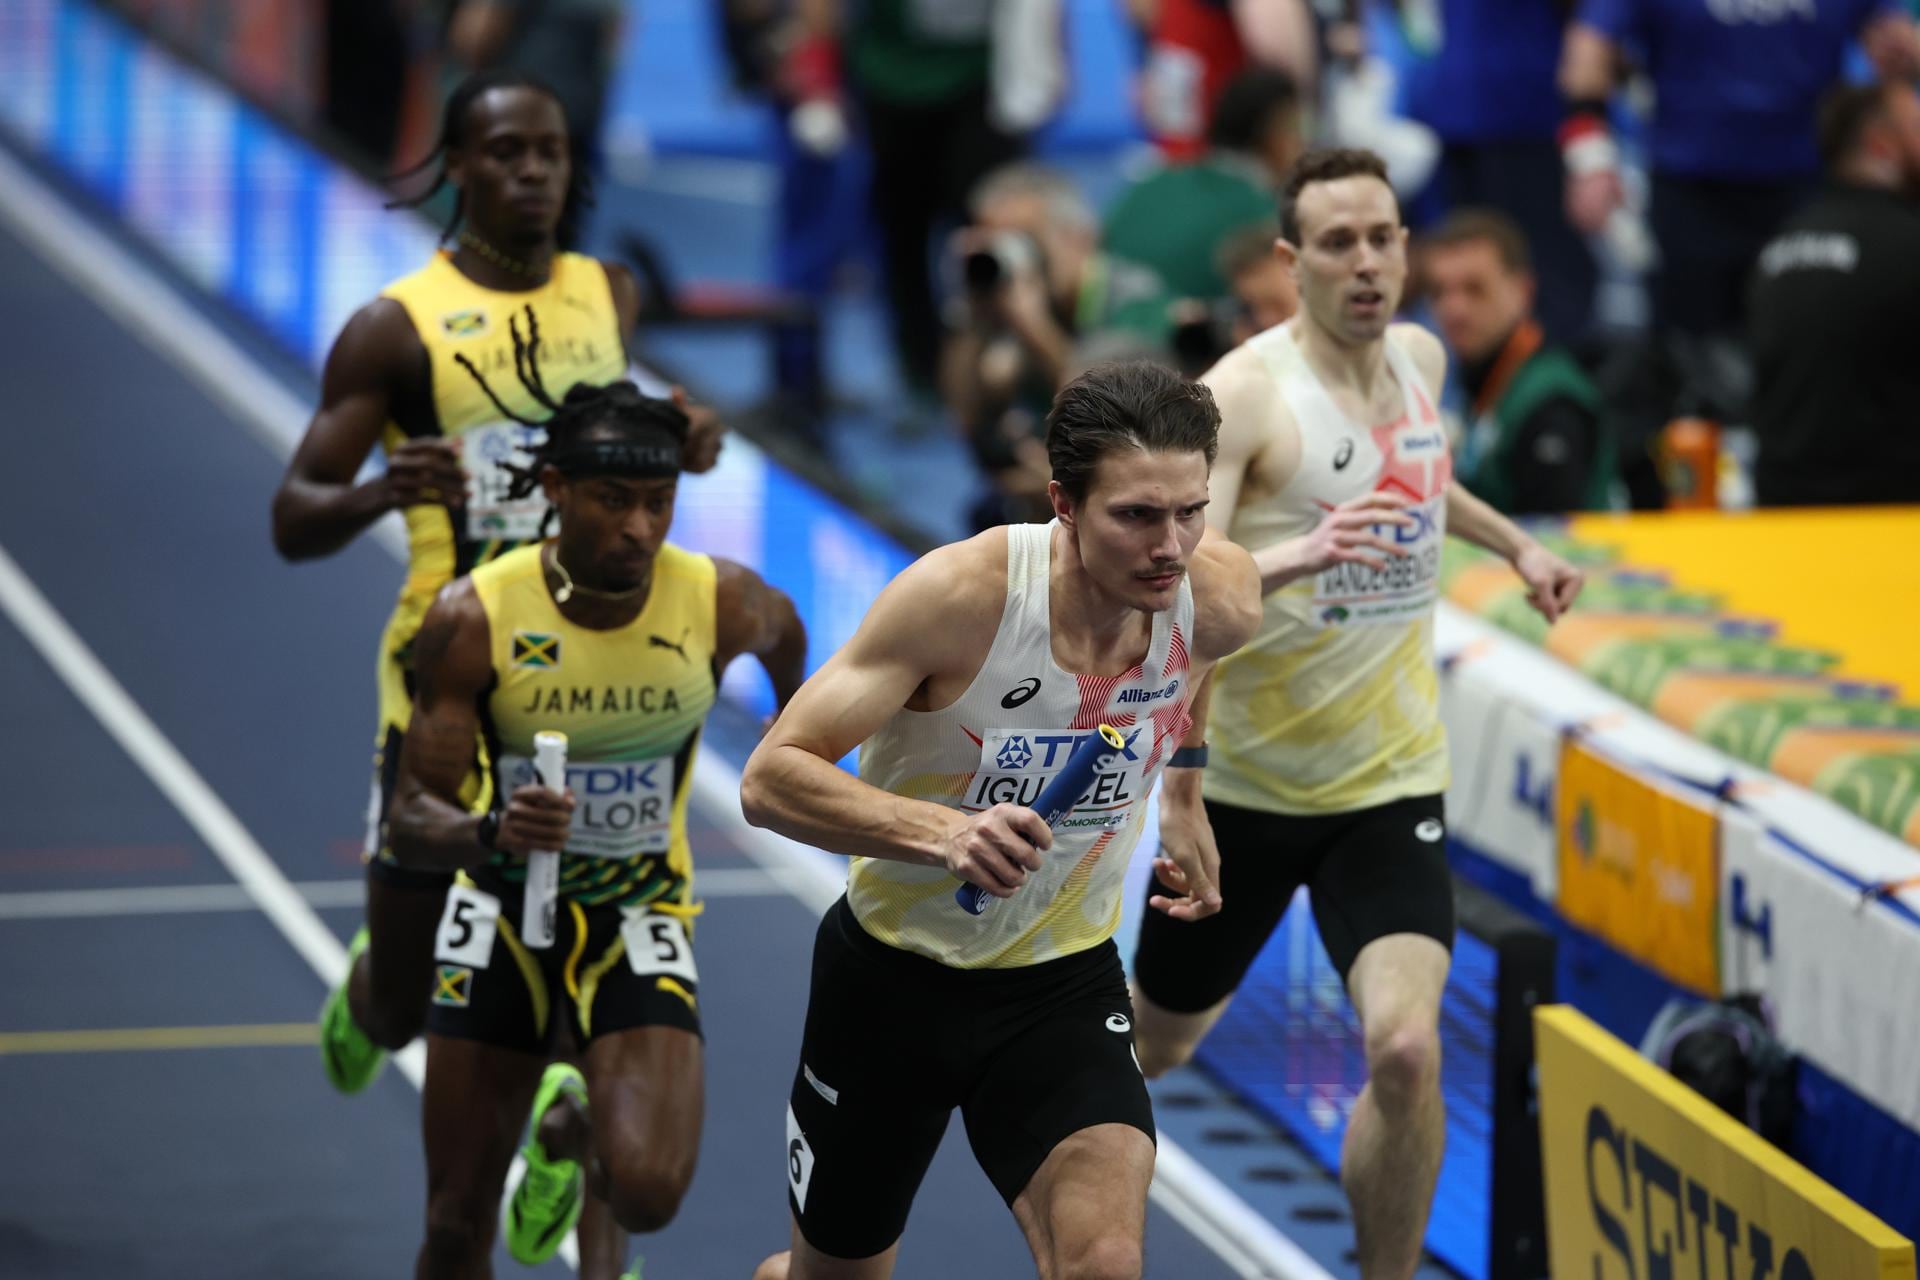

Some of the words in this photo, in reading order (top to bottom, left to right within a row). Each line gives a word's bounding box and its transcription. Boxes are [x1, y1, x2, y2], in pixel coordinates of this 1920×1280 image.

[480, 339, 599, 373] JAAICA
[523, 686, 680, 713] JAMAICA
[1117, 687, 1164, 703] Allianz
[1034, 728, 1143, 768] TK
[976, 770, 1130, 807] IGUEL
[583, 797, 663, 831] LOR
[448, 901, 476, 949] 5
[649, 922, 679, 962] 5
[789, 1138, 804, 1184] 6
[1586, 1104, 1819, 1280] SEI
